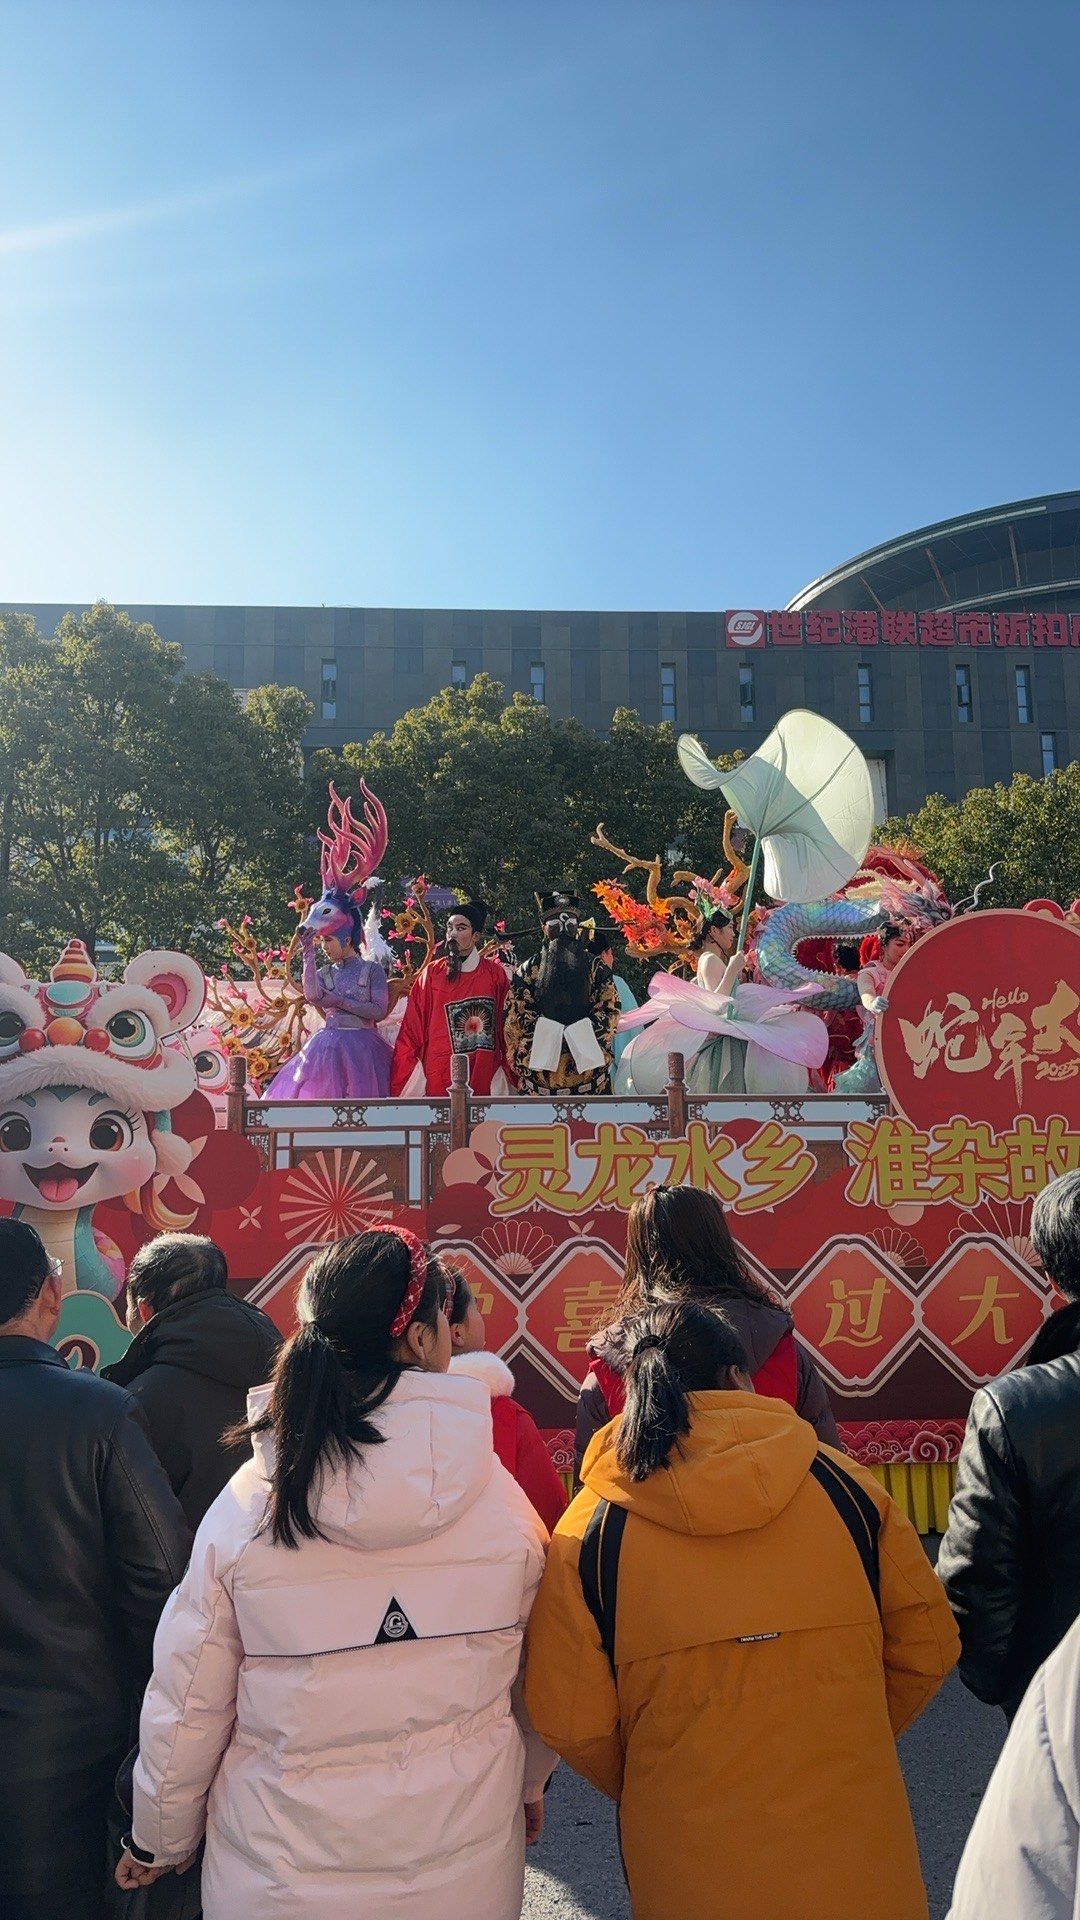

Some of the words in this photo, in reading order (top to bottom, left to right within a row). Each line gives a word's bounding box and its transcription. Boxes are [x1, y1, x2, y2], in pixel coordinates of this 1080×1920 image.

[767, 609, 1080, 648] 世纪港联超市折扣
[982, 986, 1029, 1022] Hello
[1035, 1058, 1080, 1081] 2025
[490, 1120, 816, 1216] 灵龙水乡
